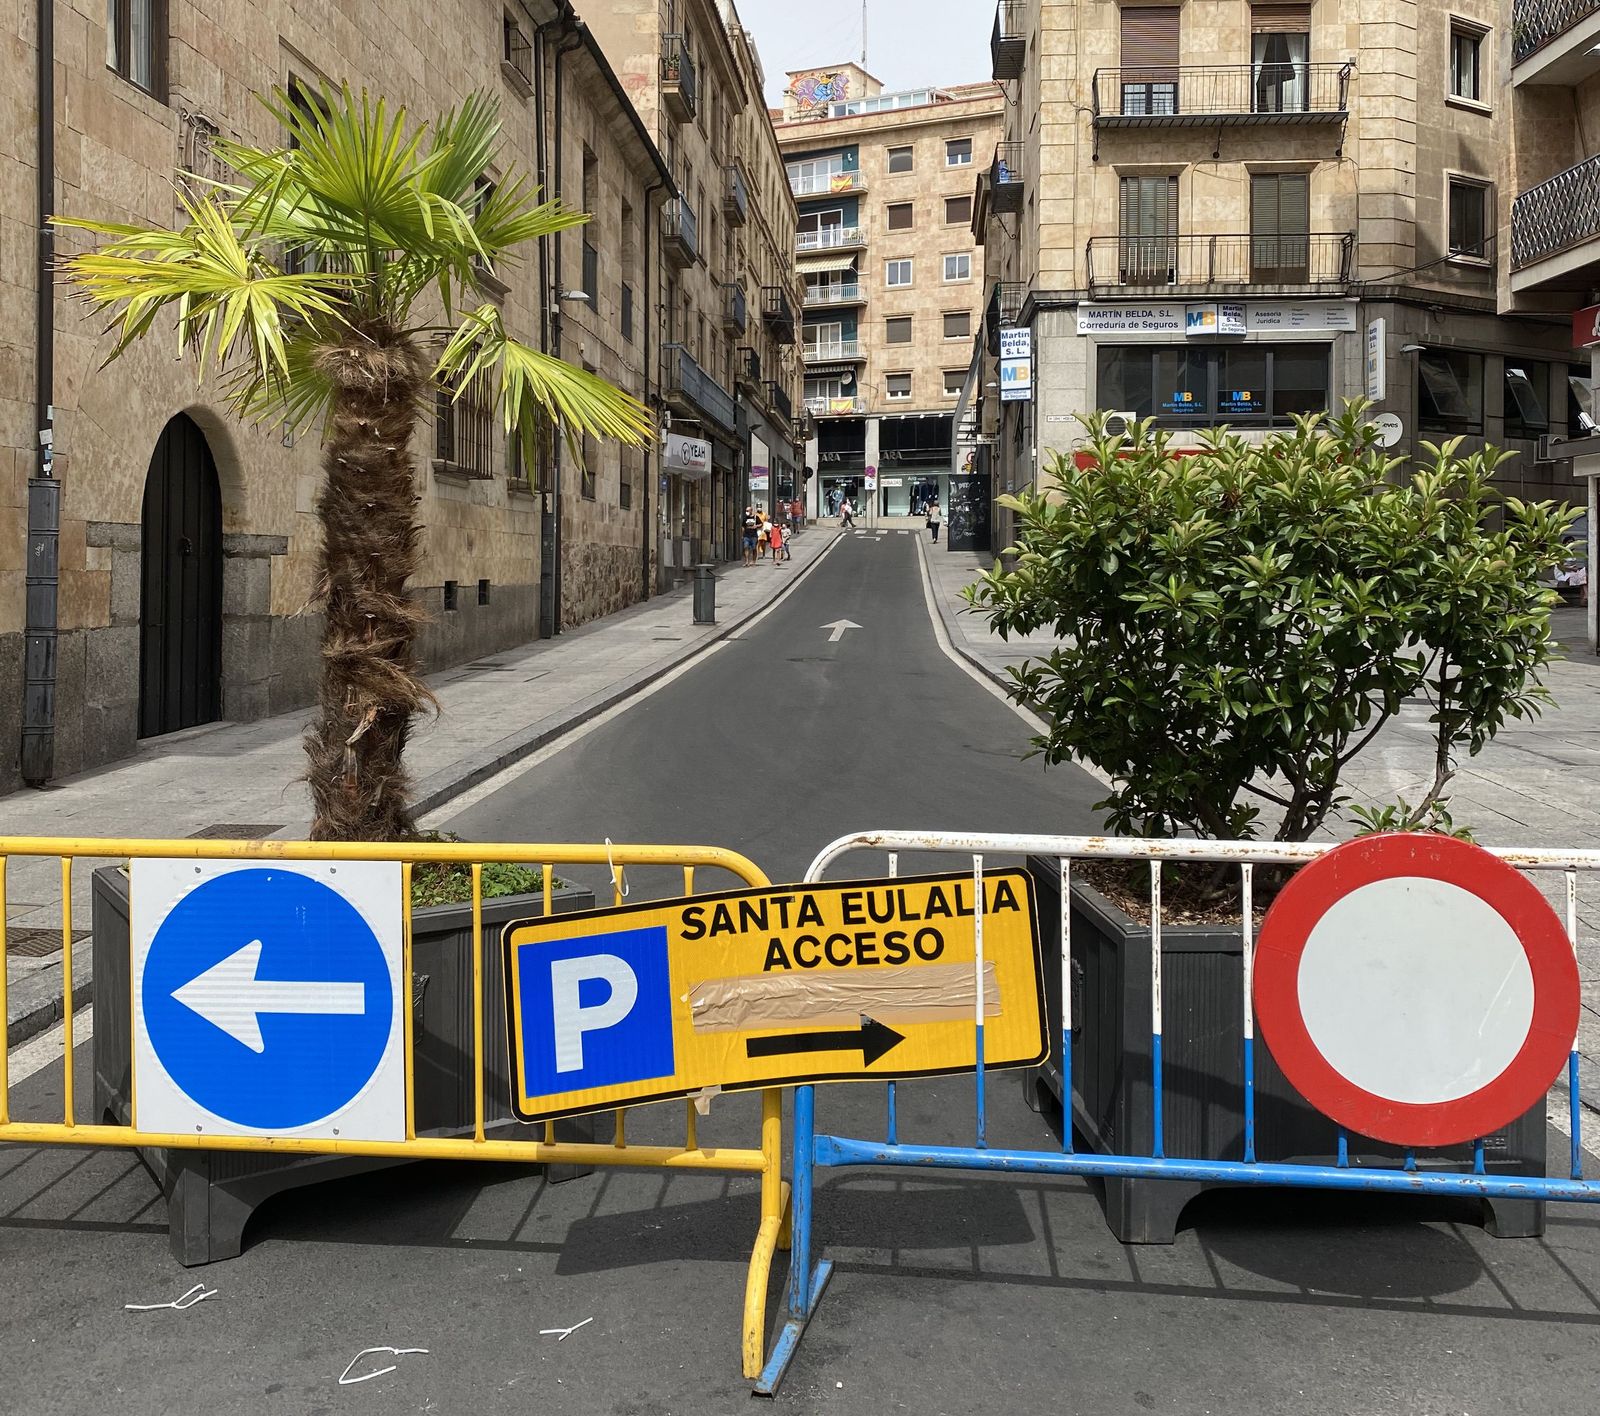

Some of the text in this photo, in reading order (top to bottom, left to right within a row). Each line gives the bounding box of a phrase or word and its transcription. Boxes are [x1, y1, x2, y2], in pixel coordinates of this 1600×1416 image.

[1088, 310, 1122, 318] MARTÍN
[1187, 311, 1216, 327] MB
[1079, 320, 1179, 330] Correduría de Seguros
[1002, 367, 1028, 381] MB
[1174, 392, 1192, 402] MB
[1232, 391, 1252, 401] MB
[690, 444, 705, 459] YEAH
[821, 453, 841, 462] ARA
[883, 451, 903, 460] ARA
[679, 879, 1021, 941] SANTA EULALIA
[763, 926, 945, 972] ACCESO
[551, 953, 638, 1074] P
